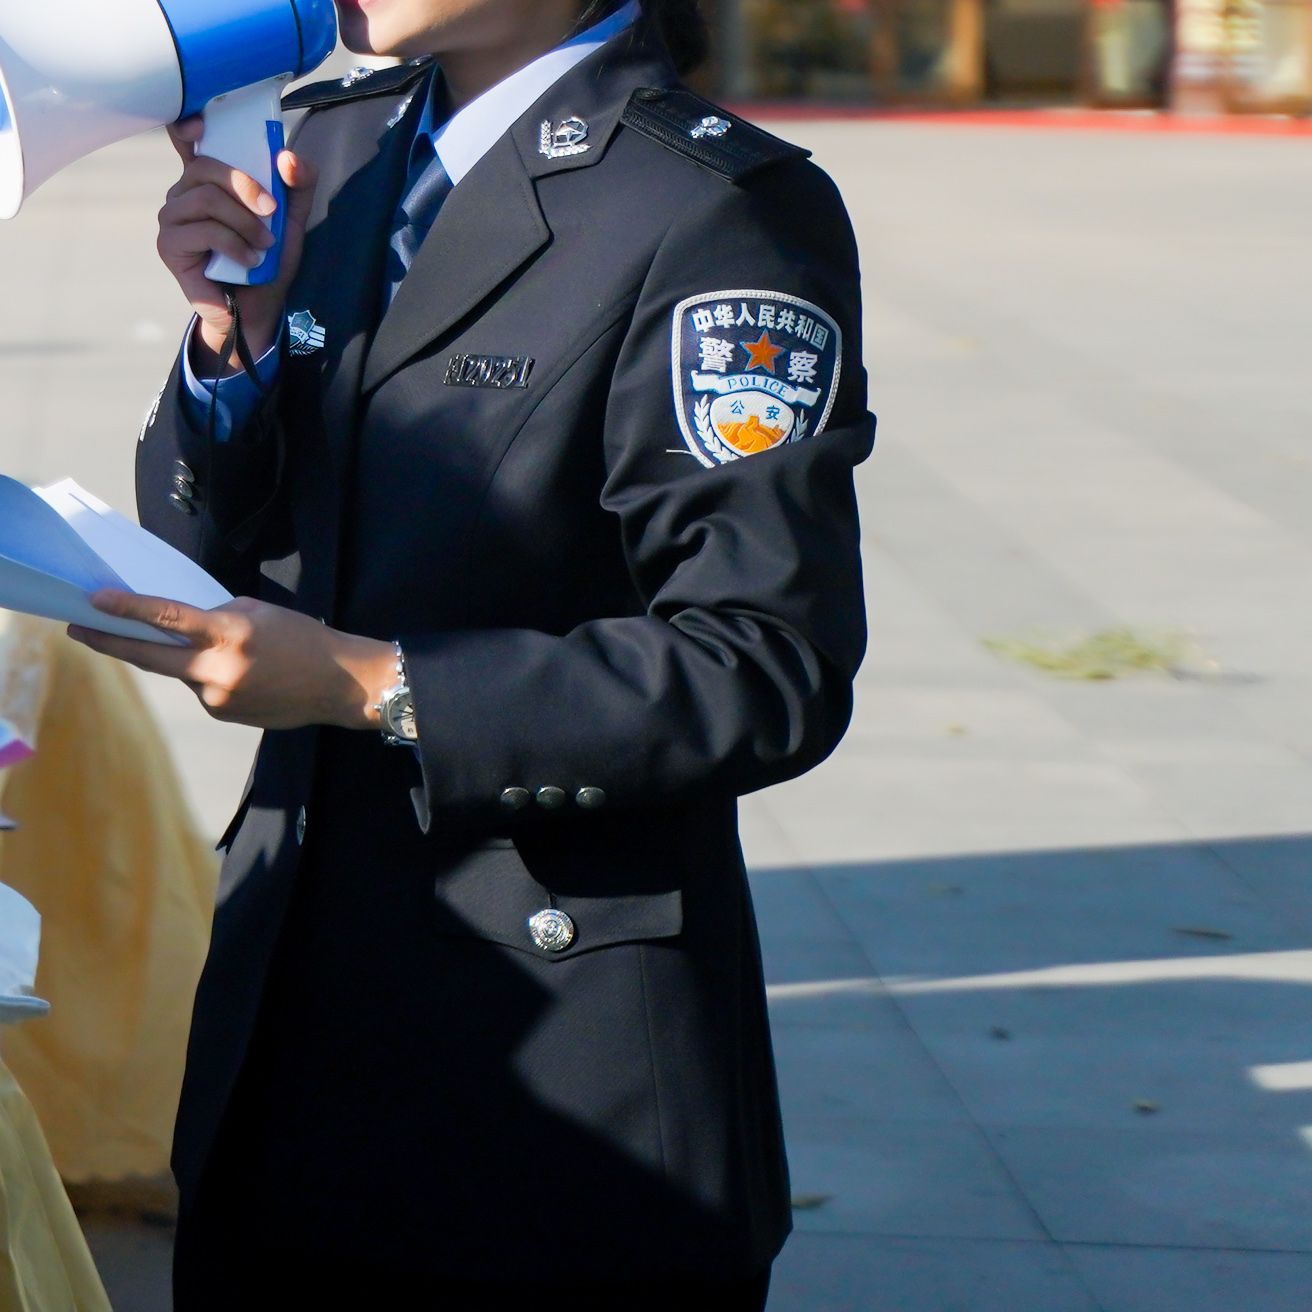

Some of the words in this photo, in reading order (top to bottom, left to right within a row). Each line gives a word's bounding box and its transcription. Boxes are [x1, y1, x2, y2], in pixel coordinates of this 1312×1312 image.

[692, 302, 829, 352] 中华人民共和国
[727, 375, 788, 398] POLICE
